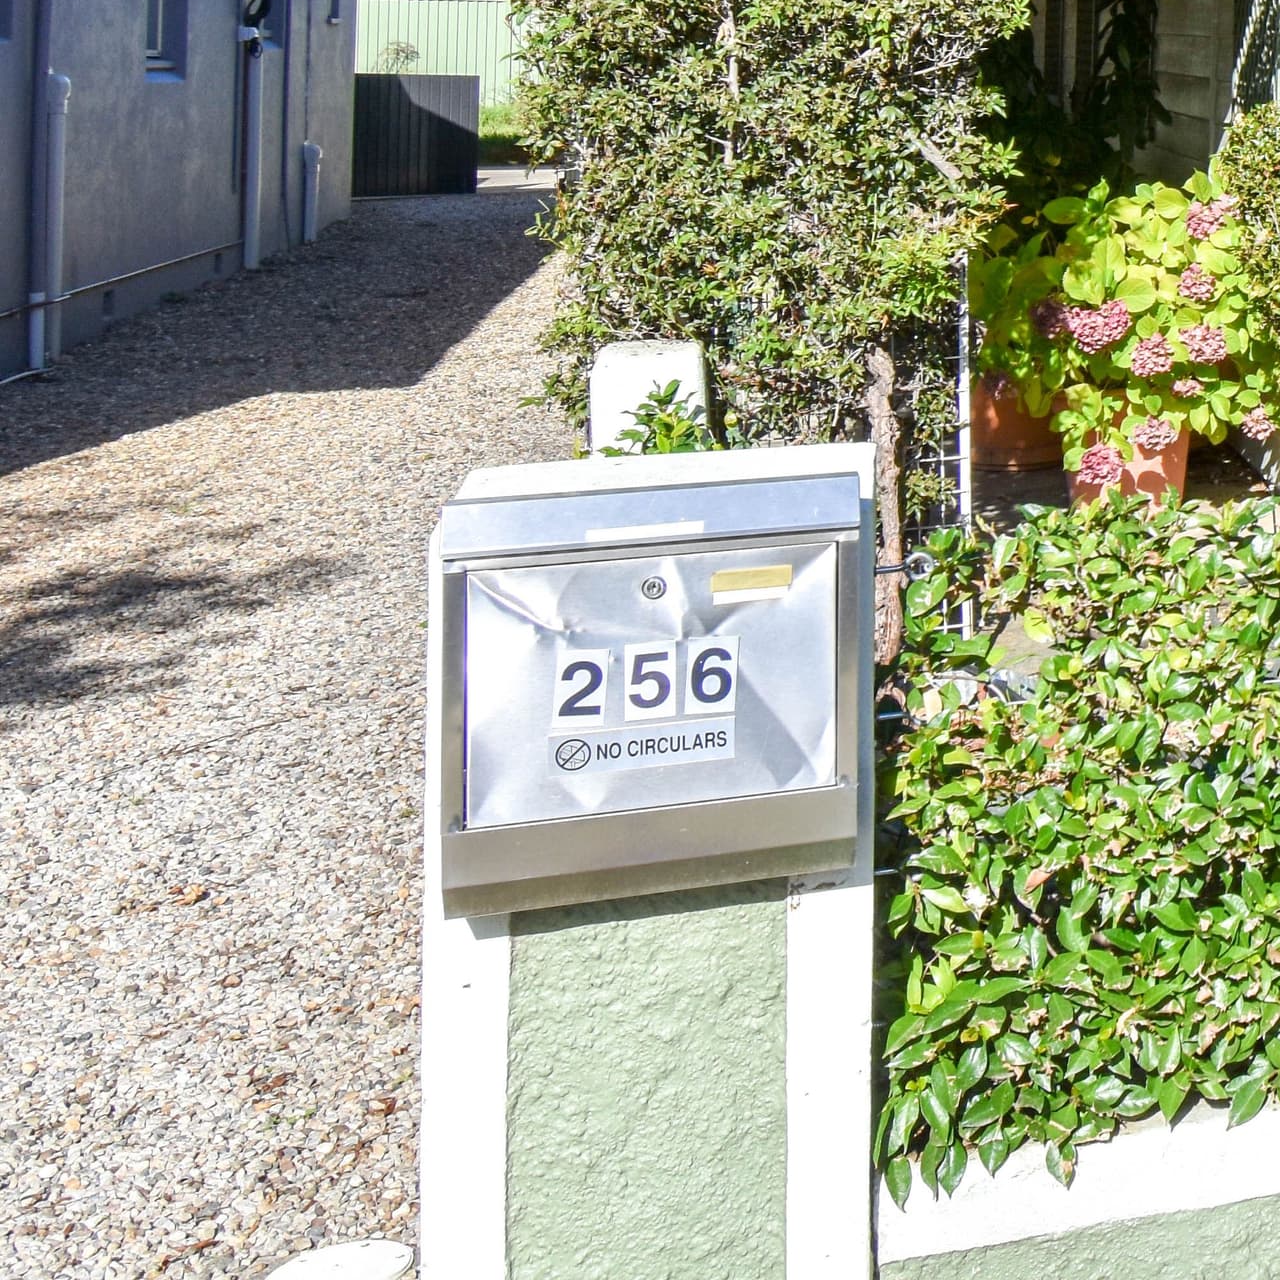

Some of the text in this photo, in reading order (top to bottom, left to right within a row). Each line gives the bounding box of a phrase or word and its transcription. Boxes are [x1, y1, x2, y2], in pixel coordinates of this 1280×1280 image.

[558, 647, 733, 716] 256
[596, 730, 728, 761] NO CIRCULARS
